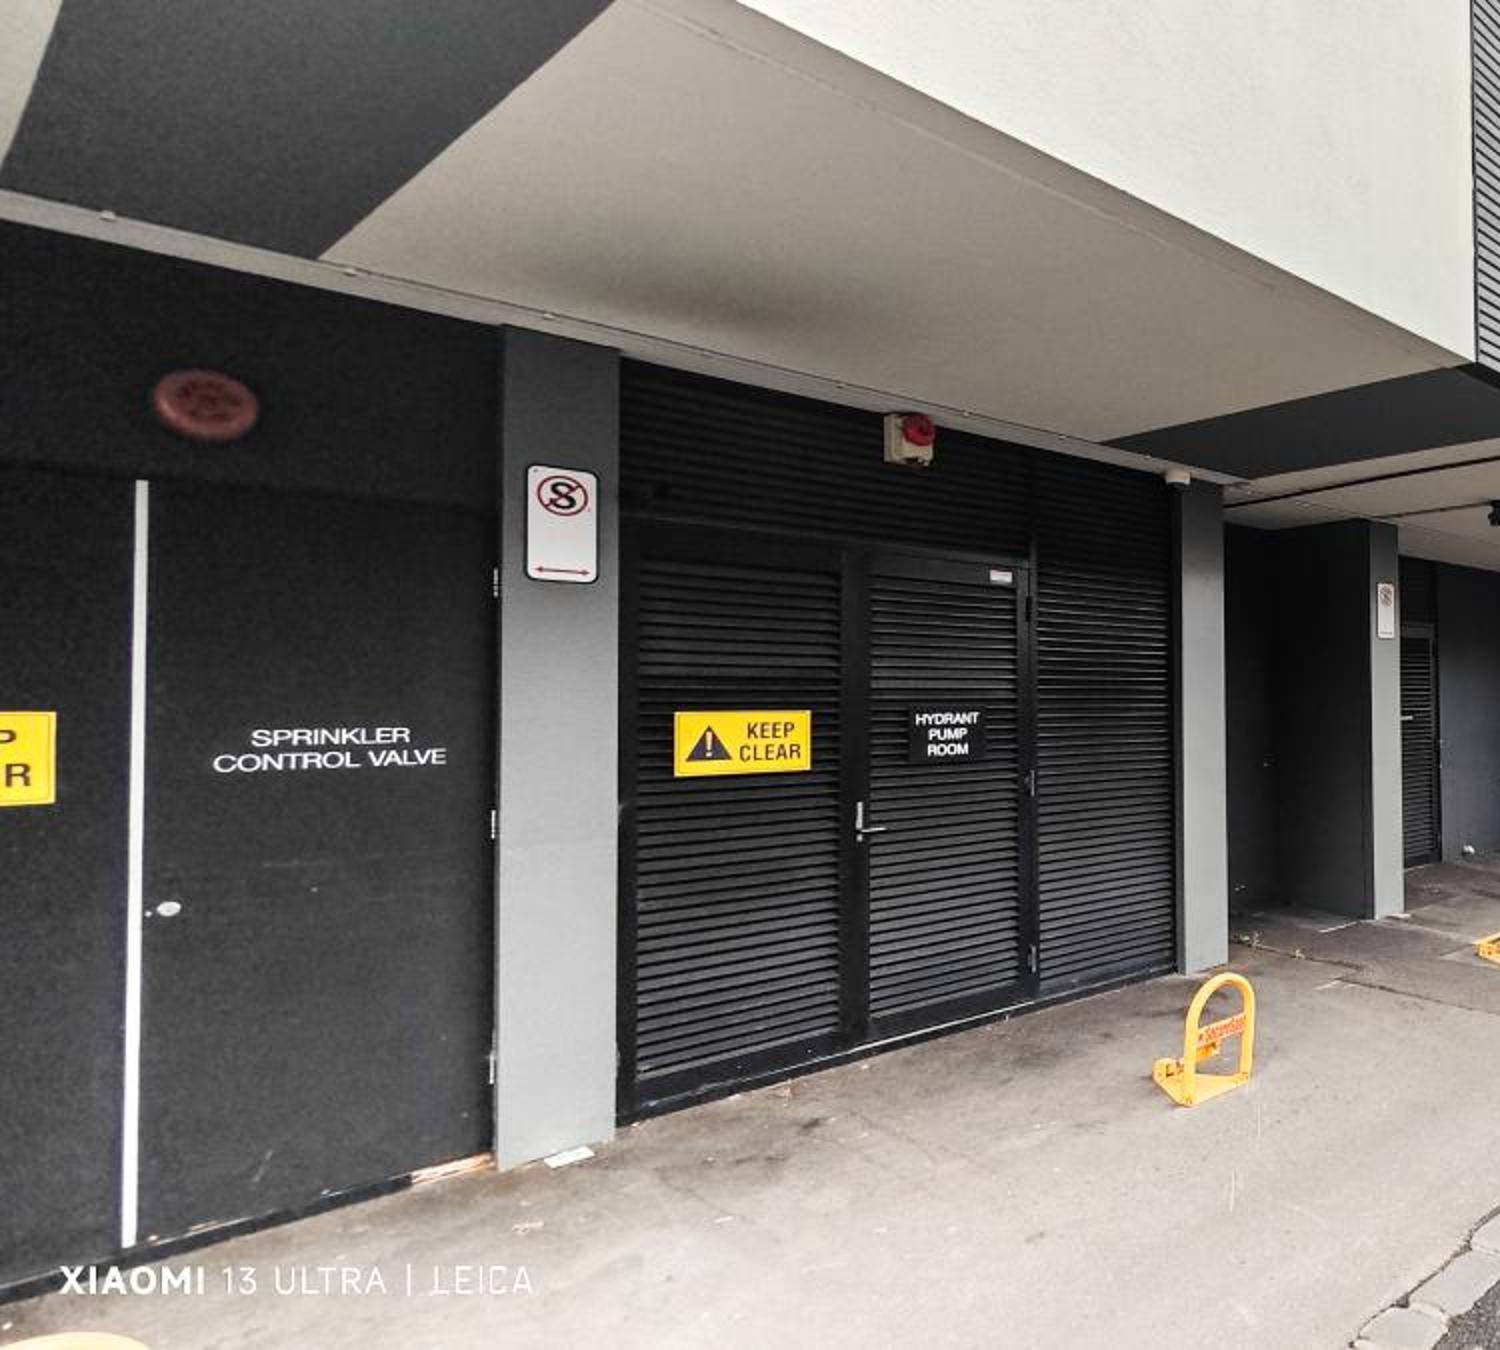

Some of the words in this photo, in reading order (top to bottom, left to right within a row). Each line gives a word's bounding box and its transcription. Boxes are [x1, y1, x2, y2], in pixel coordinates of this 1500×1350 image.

[915, 712, 979, 726] HYDRANT
[250, 726, 411, 747] SPRINKLER
[746, 722, 796, 739] KEEP
[928, 727, 969, 741] PUMP
[739, 744, 801, 762] CLEAR
[926, 742, 970, 757] ROOM
[212, 751, 362, 773] CONTROL
[368, 748, 448, 767] VALVE
